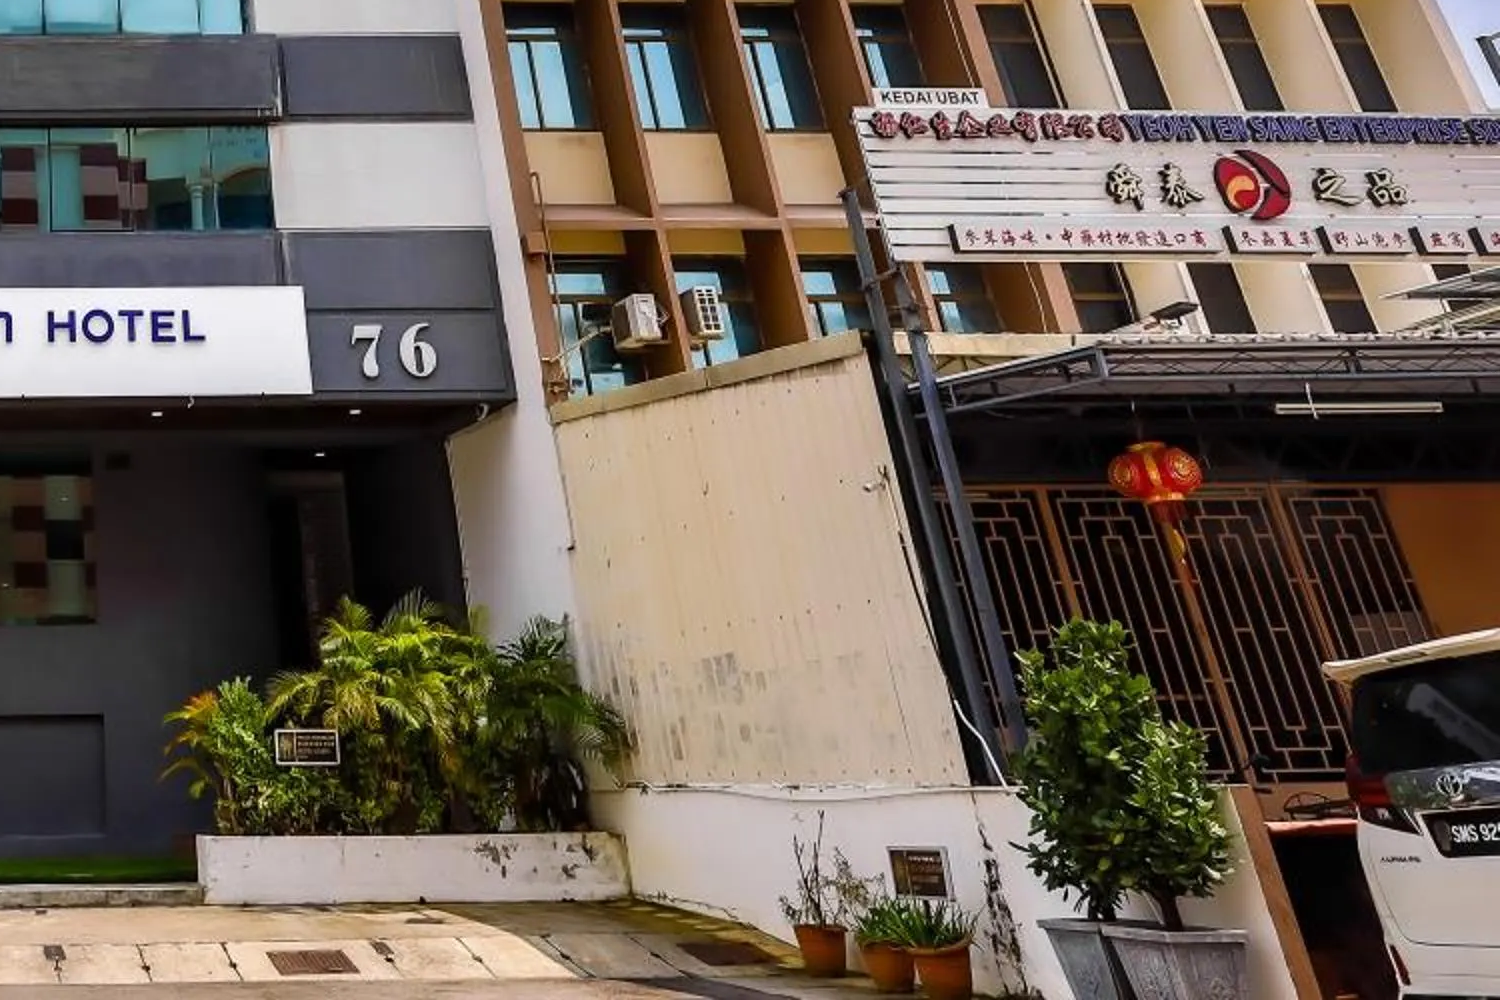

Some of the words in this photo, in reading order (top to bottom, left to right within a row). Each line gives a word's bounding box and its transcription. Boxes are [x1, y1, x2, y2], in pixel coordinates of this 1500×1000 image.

[880, 90, 933, 105] KEDAI
[935, 91, 980, 105] UBAT
[1120, 113, 1197, 143] YEOH
[1192, 114, 1249, 143] YEN
[1249, 115, 1321, 143] SANG
[1318, 115, 1471, 144] ENTERPRISE
[1311, 166, 1411, 207] 之品
[46, 309, 206, 345] HOTEL
[351, 322, 438, 379] 76
[1451, 825, 1479, 843] SMS
